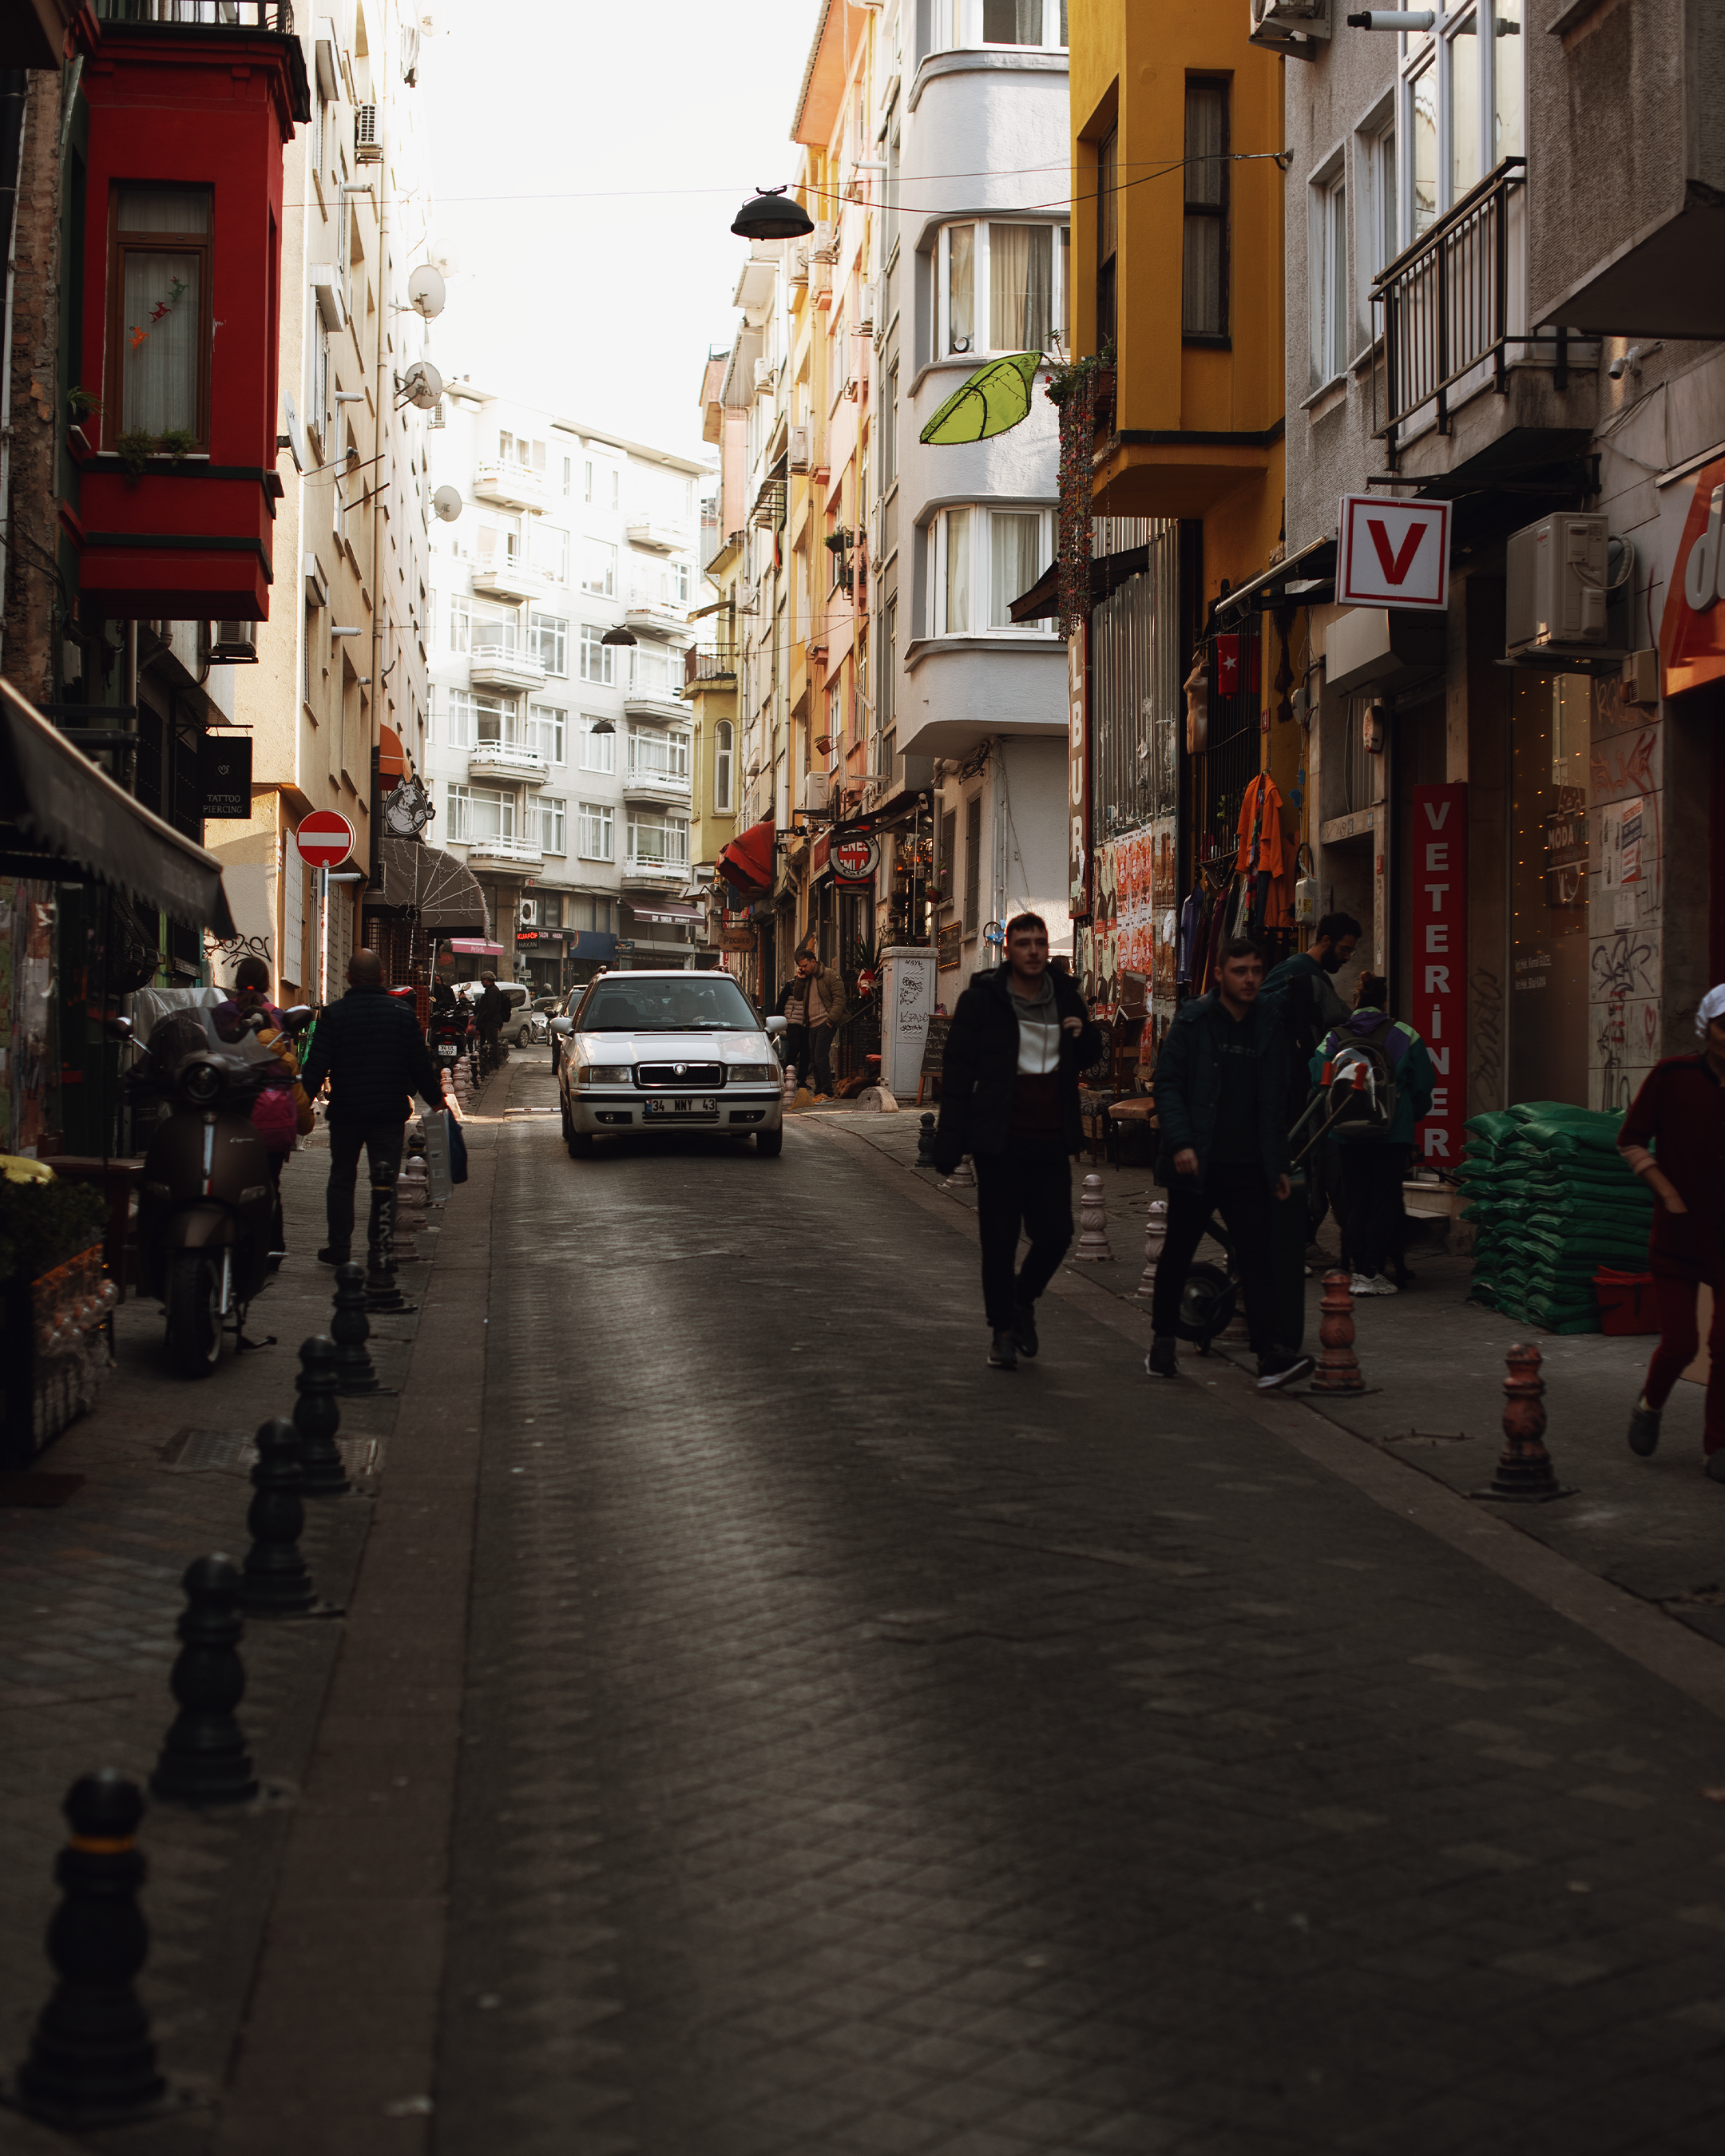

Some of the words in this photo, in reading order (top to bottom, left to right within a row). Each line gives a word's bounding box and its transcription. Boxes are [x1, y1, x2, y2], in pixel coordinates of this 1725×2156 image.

[1366, 519, 1428, 585] V
[1684, 482, 1725, 610] d
[203, 805, 243, 814] PIERCING
[724, 936, 750, 945] PECHKO
[1423, 802, 1451, 1157] VETERİNER
[652, 1100, 665, 1112] 34
[674, 1099, 692, 1111] NNY
[703, 1099, 715, 1111] 43
